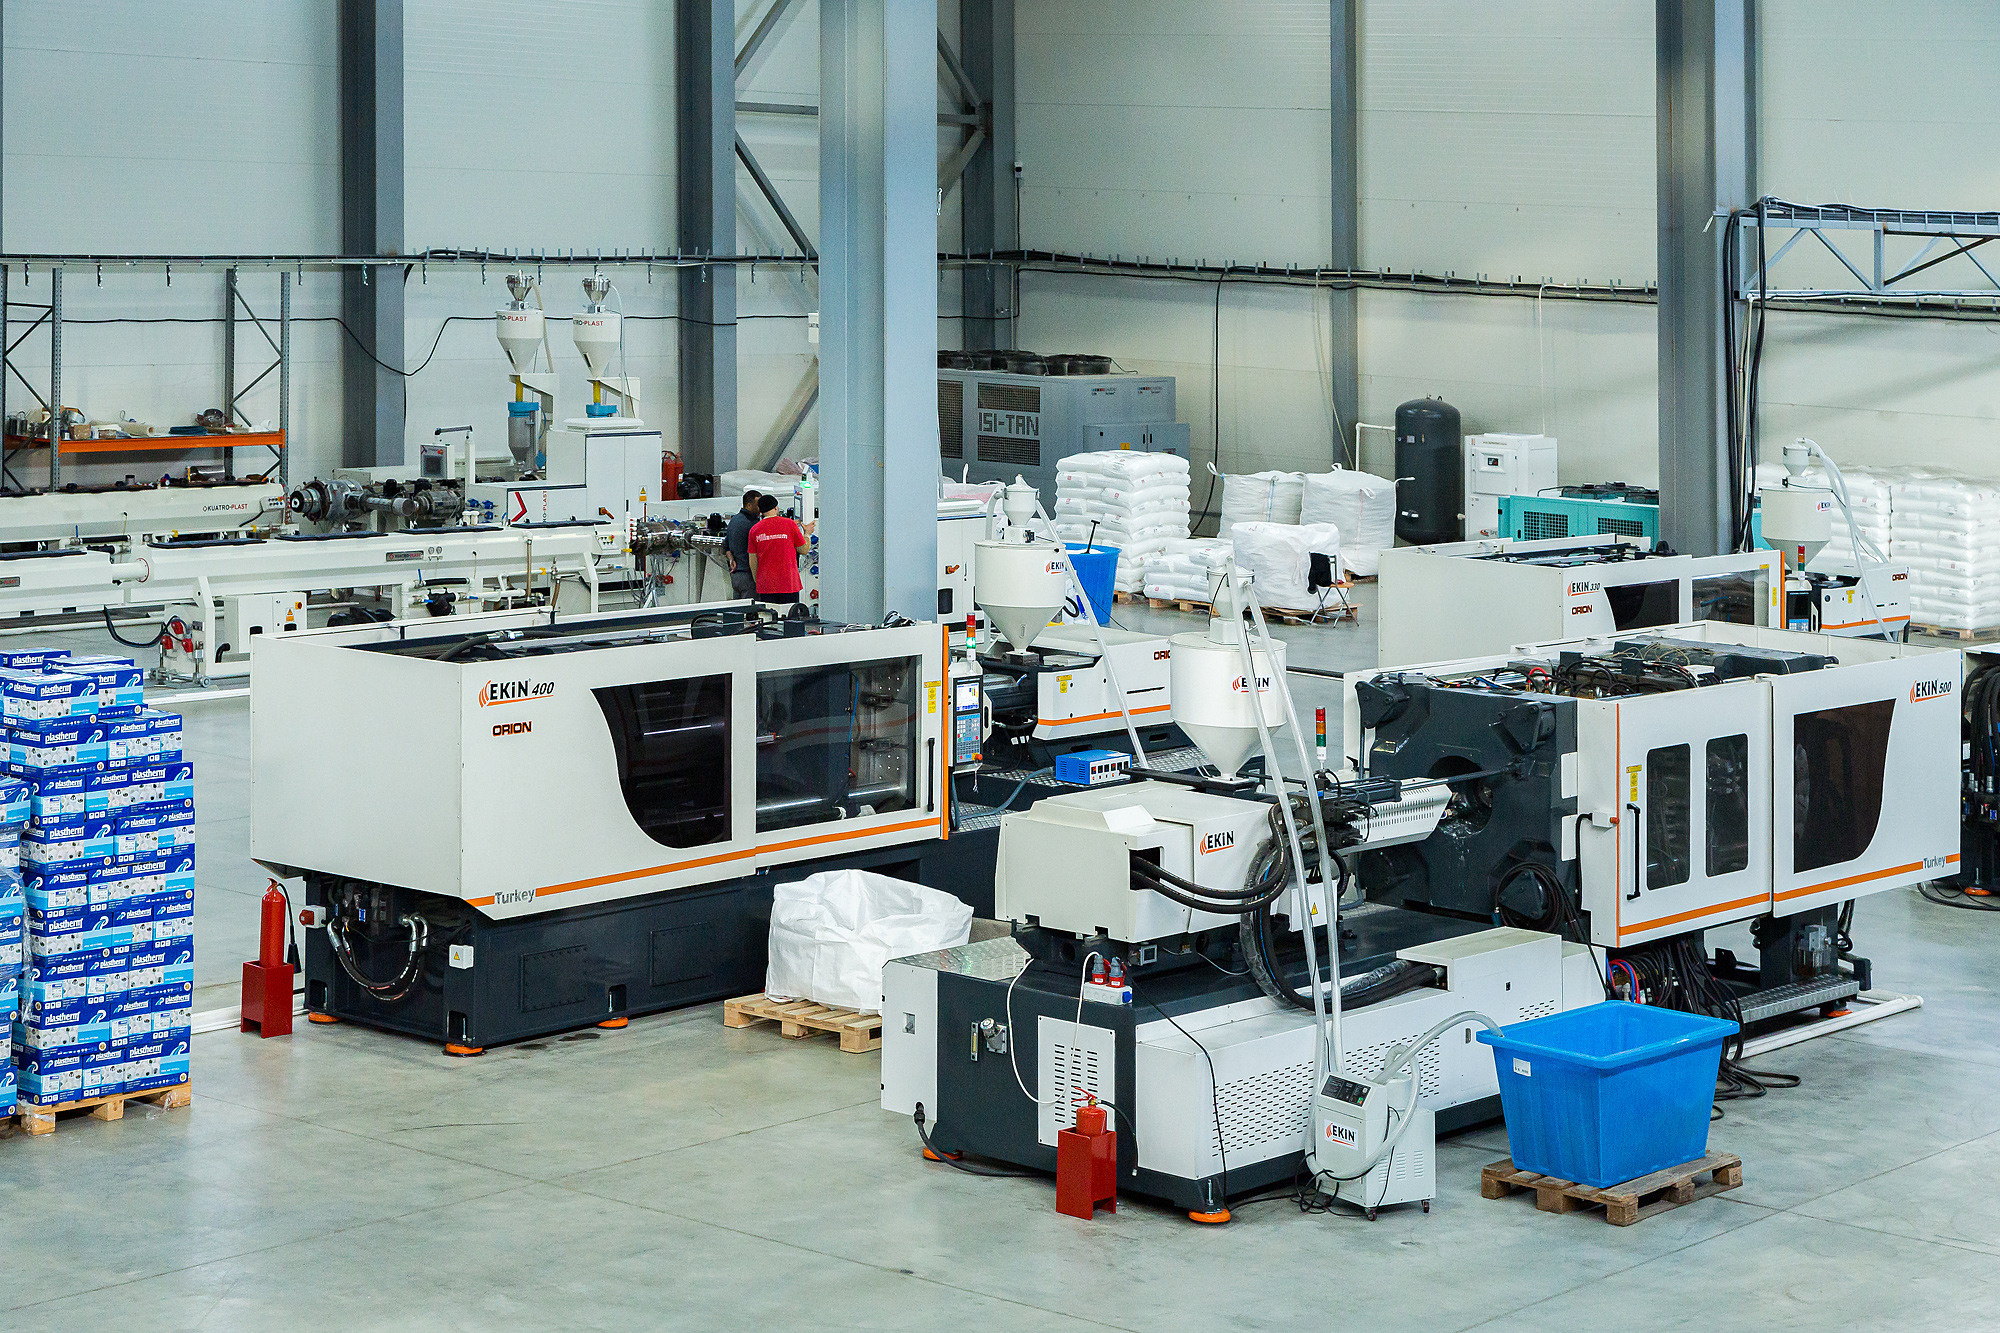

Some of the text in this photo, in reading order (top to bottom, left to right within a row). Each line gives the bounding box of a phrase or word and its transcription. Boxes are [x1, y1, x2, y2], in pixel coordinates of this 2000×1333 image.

[978, 411, 1039, 436] ISI-TAN
[1571, 604, 1593, 616] ORION
[531, 682, 555, 696] 400
[1938, 681, 1952, 693] 500
[492, 720, 532, 737] ORION
[45, 730, 79, 744] plastherm
[132, 768, 167, 781] plastherm
[50, 826, 85, 840] plastherm
[1924, 856, 1946, 869] Turkey
[494, 889, 535, 904] Turkey
[49, 918, 84, 933] plastherm
[132, 952, 166, 966] plastherm
[45, 1012, 81, 1026] plastherm
[129, 1044, 163, 1059] plastherm
